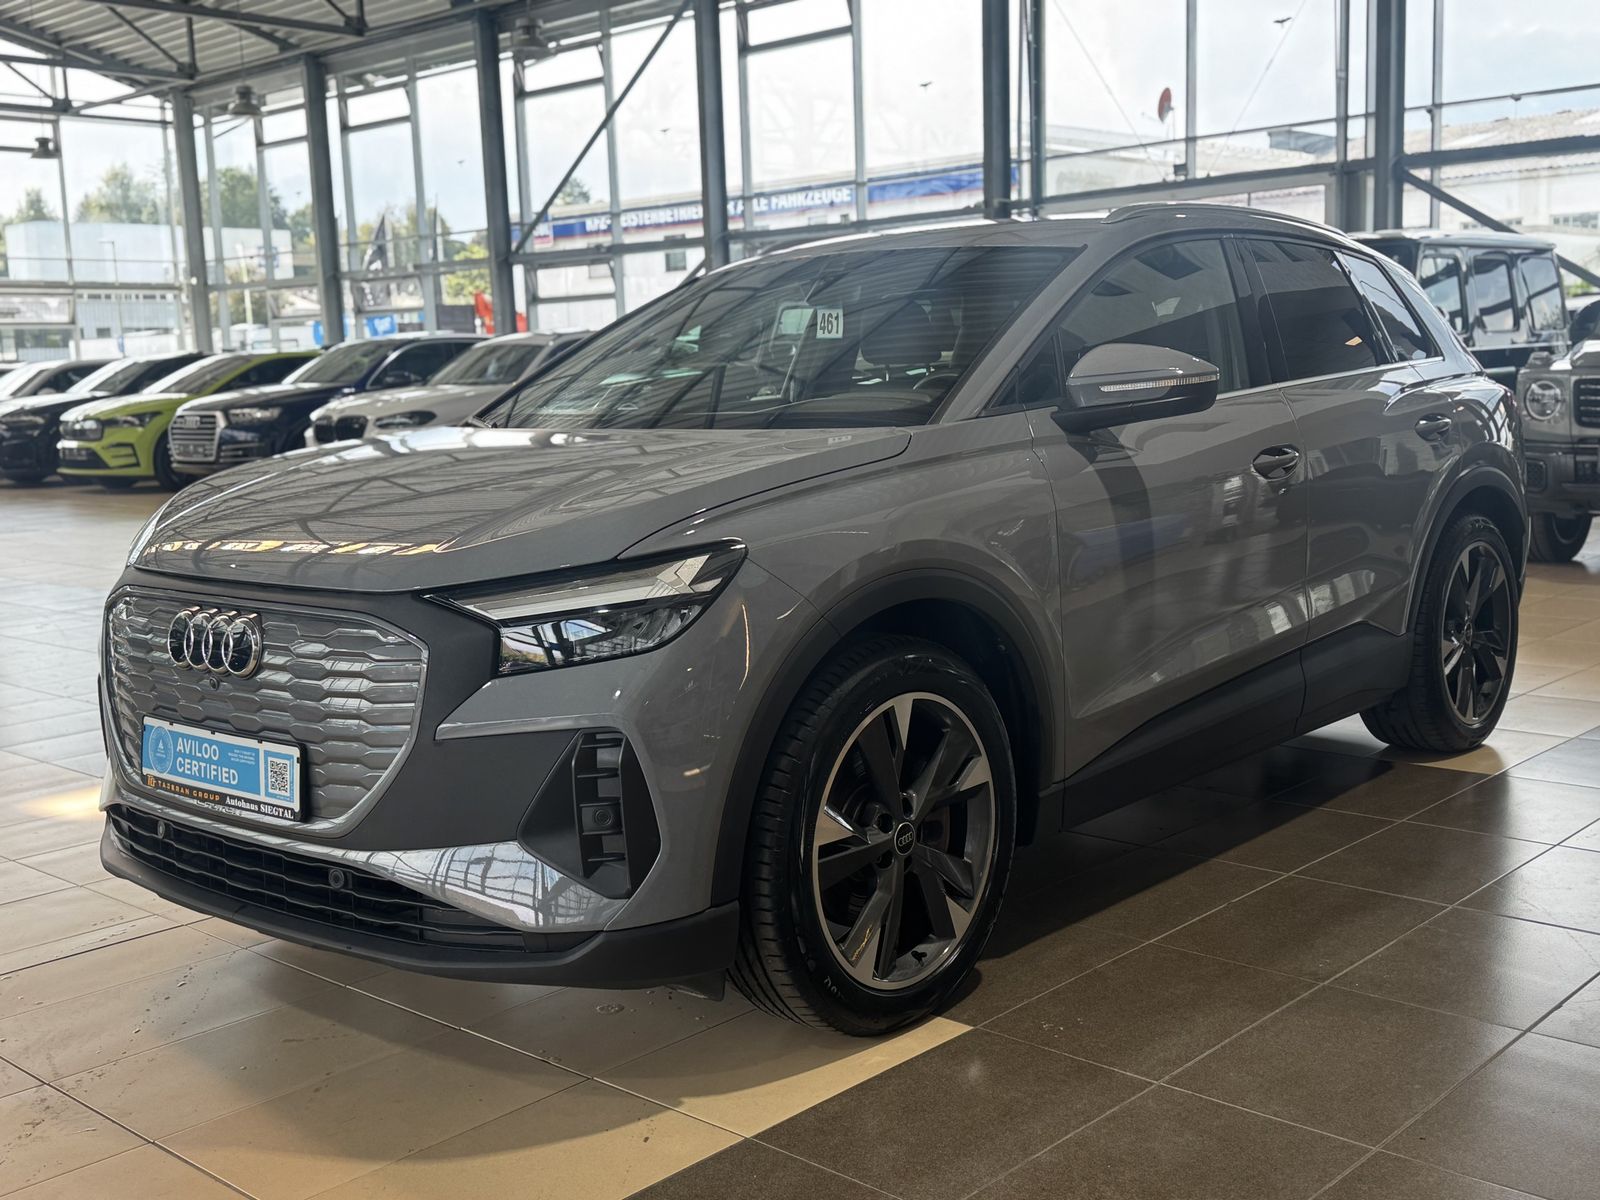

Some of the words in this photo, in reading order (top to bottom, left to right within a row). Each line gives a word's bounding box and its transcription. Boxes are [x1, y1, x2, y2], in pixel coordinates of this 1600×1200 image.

[771, 187, 852, 210] FAHRZEUGE
[819, 311, 840, 335] 461
[176, 736, 220, 761] AVILOO
[176, 756, 239, 785] CERTIFIED
[192, 790, 220, 801] GROUP
[225, 795, 259, 812] Autohaus
[260, 803, 294, 819] SIEGTAL
